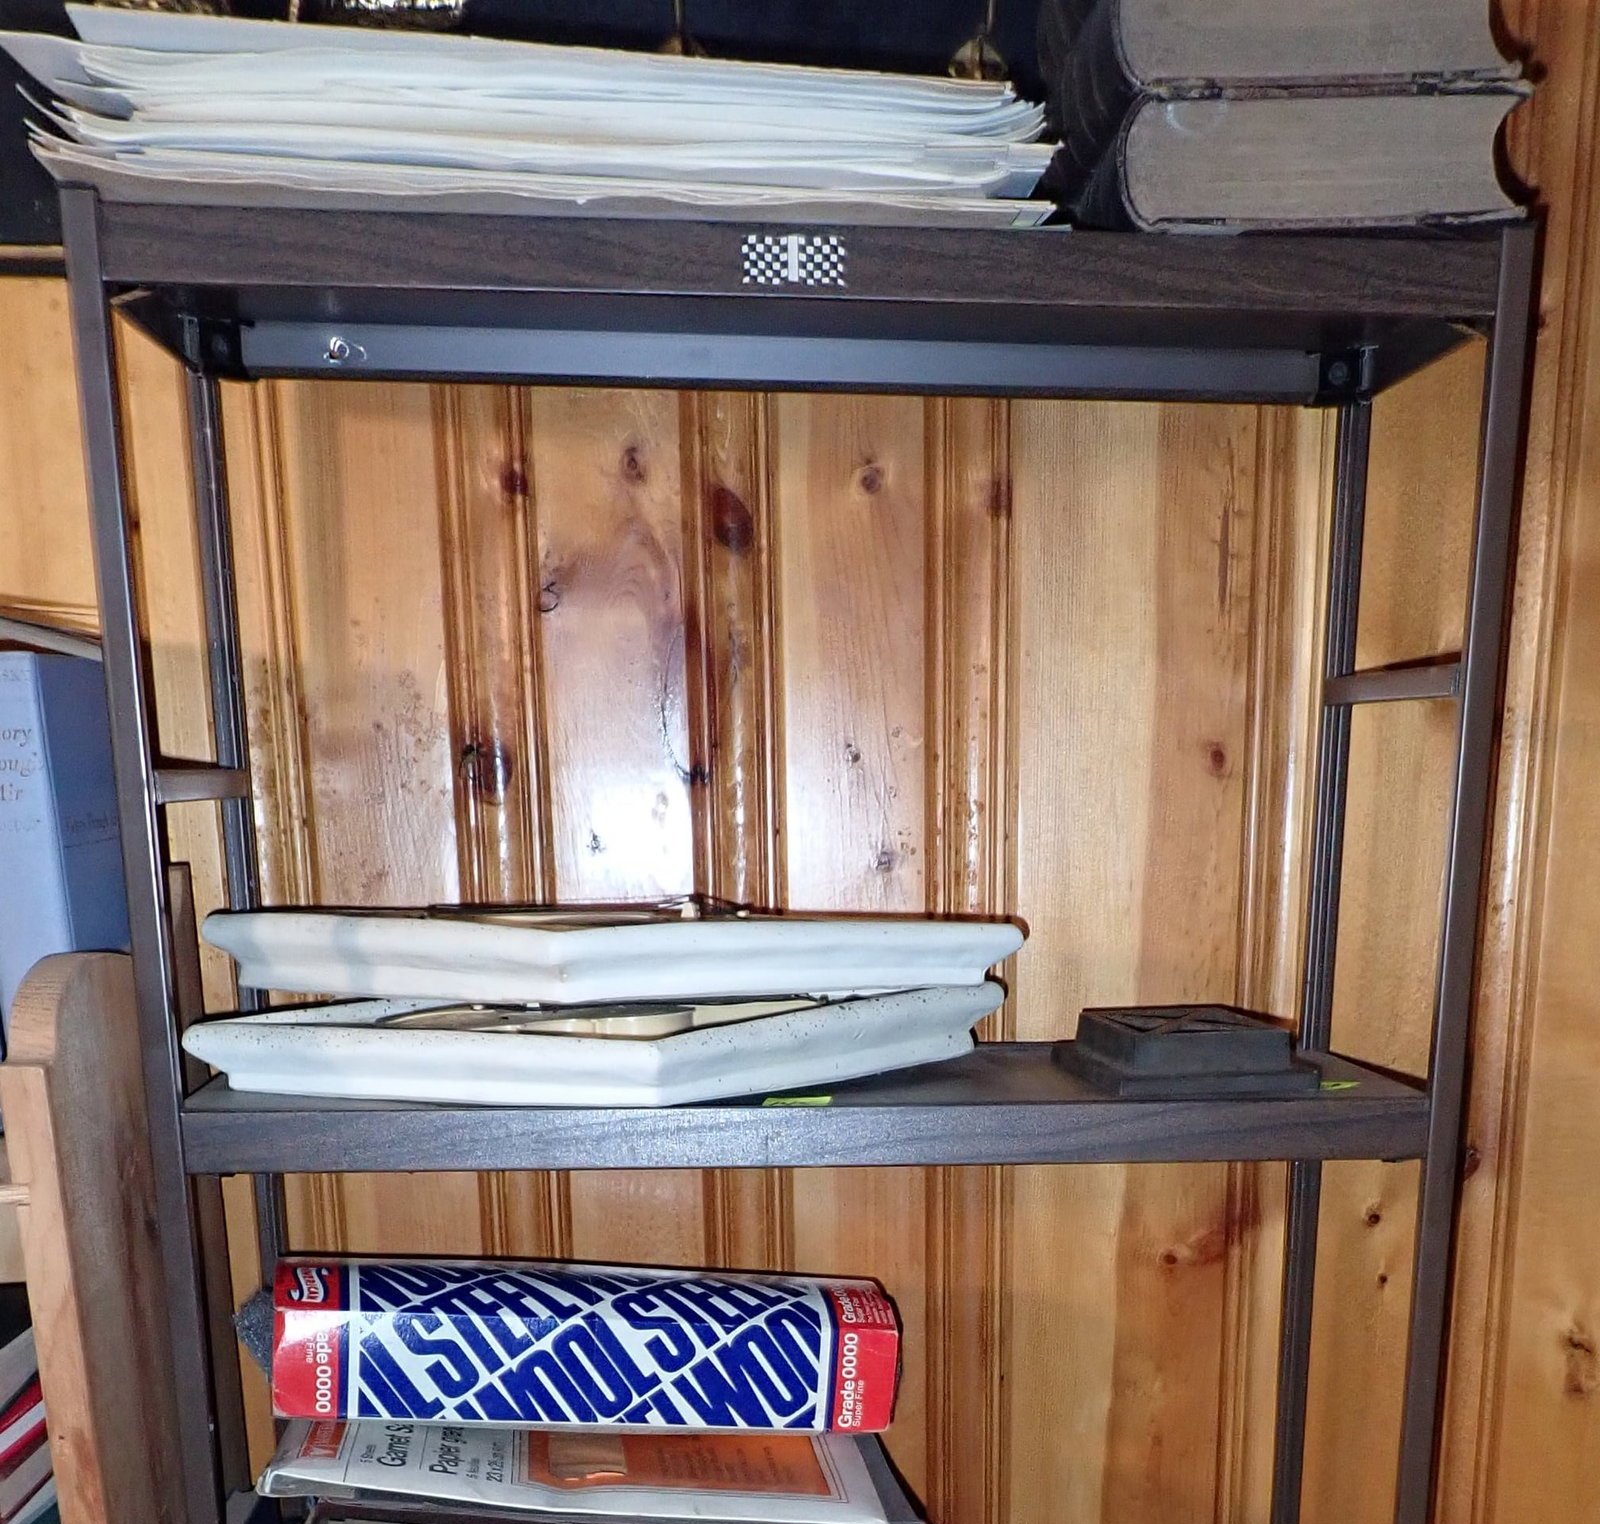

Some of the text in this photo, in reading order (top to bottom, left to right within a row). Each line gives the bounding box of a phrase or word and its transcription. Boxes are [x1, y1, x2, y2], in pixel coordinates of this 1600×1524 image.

[393, 1273, 584, 1398] STEEL
[611, 1279, 790, 1373] STEEL
[316, 1365, 331, 1413] 0000
[838, 1332, 858, 1428] Grade 0000
[852, 1379, 865, 1427] Super Fine
[376, 1434, 411, 1467] Garnet
[428, 1444, 464, 1475] Papier
